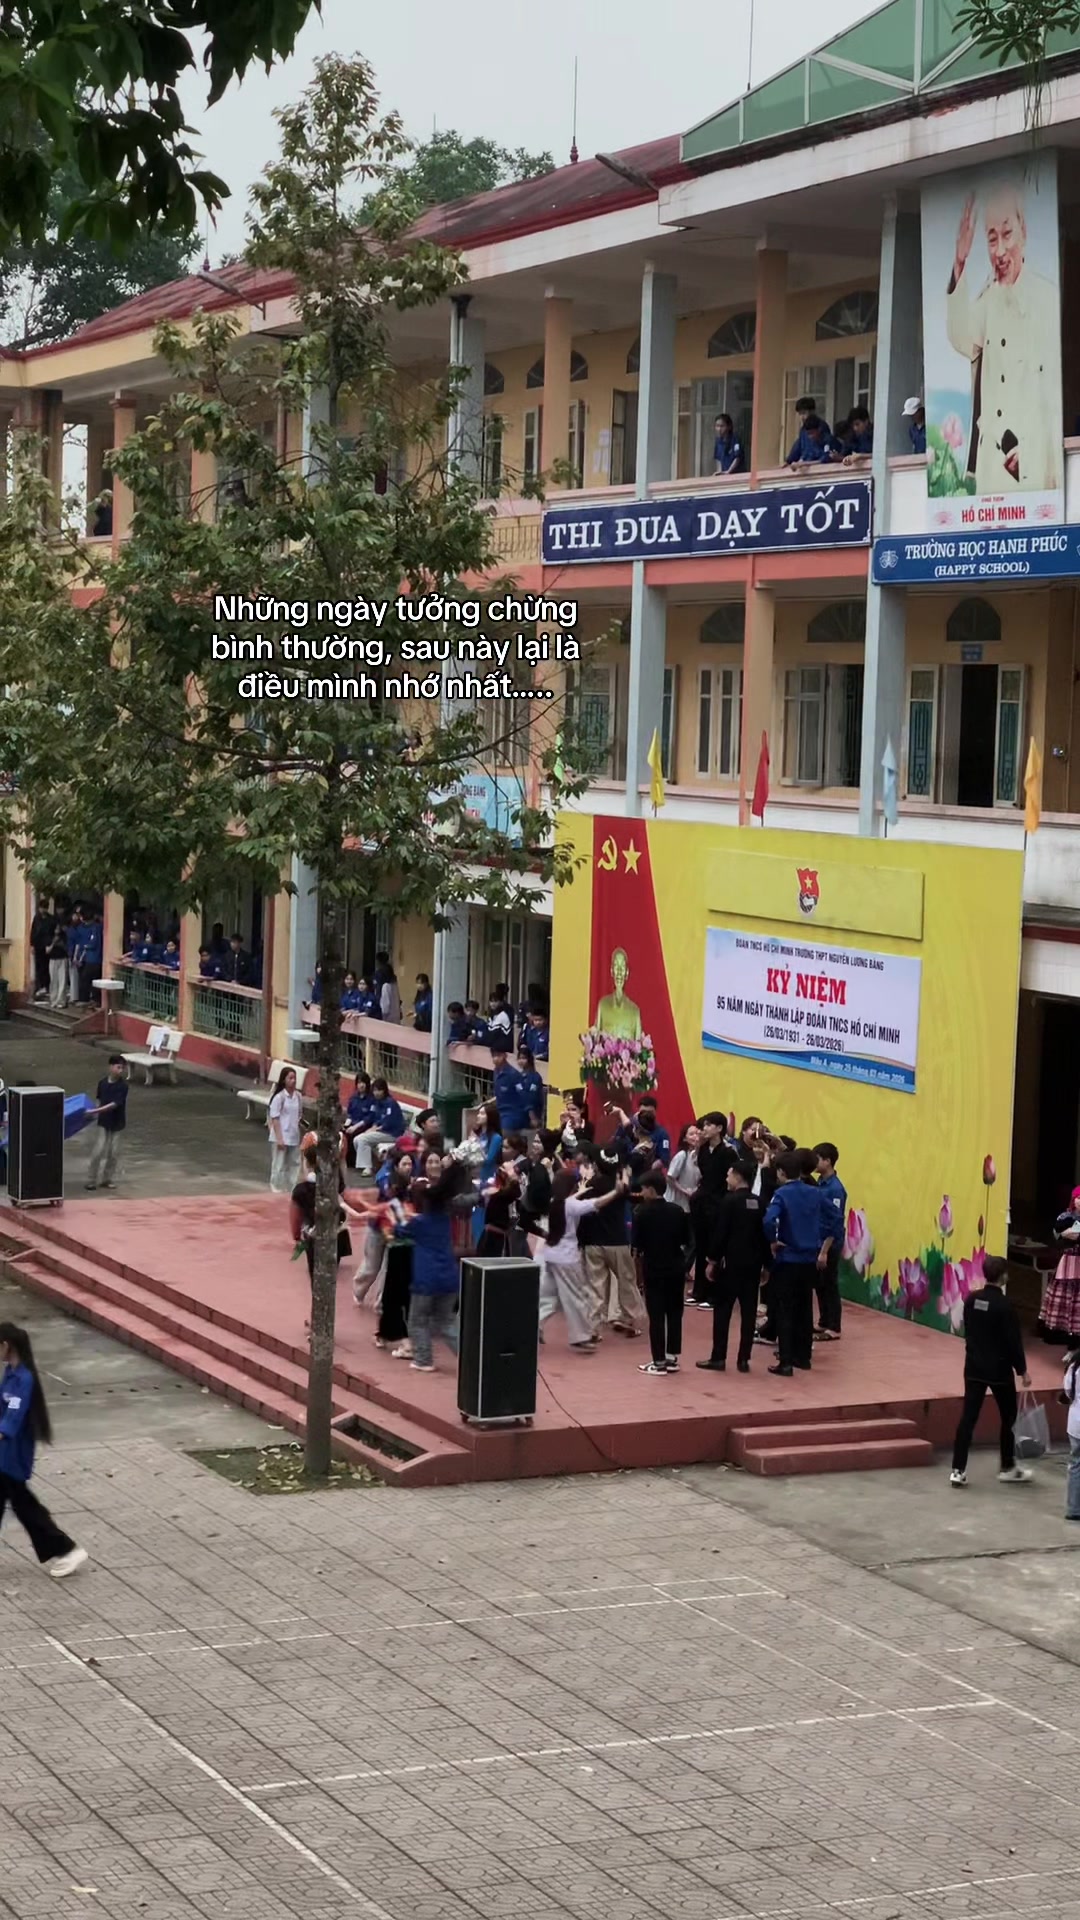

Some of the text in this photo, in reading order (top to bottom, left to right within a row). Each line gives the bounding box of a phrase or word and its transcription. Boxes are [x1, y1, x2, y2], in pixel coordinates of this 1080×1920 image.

[549, 486, 859, 550] THI ĐUA DẠY TỐT
[978, 504, 995, 521] CHÍ
[998, 505, 1025, 520] MINH
[905, 531, 1068, 560] TRƯỜNG HỌC HẠNH PHÚC
[934, 562, 1030, 578] (HAPPY SCHOOL)
[767, 963, 846, 1007] KỶ NIỆM
[717, 995, 726, 1010] 95
[727, 995, 743, 1014] NĂM
[745, 1000, 764, 1017] NGÀY
[765, 1002, 789, 1022] THÀNH
[791, 1007, 805, 1027] LẬP
[806, 1010, 827, 1029] ĐOÀN
[829, 1016, 848, 1033] TNCS
[863, 1021, 877, 1039] CHÍ
[879, 1026, 900, 1044] MINH
[763, 1025, 800, 1043] (26/03/1931
